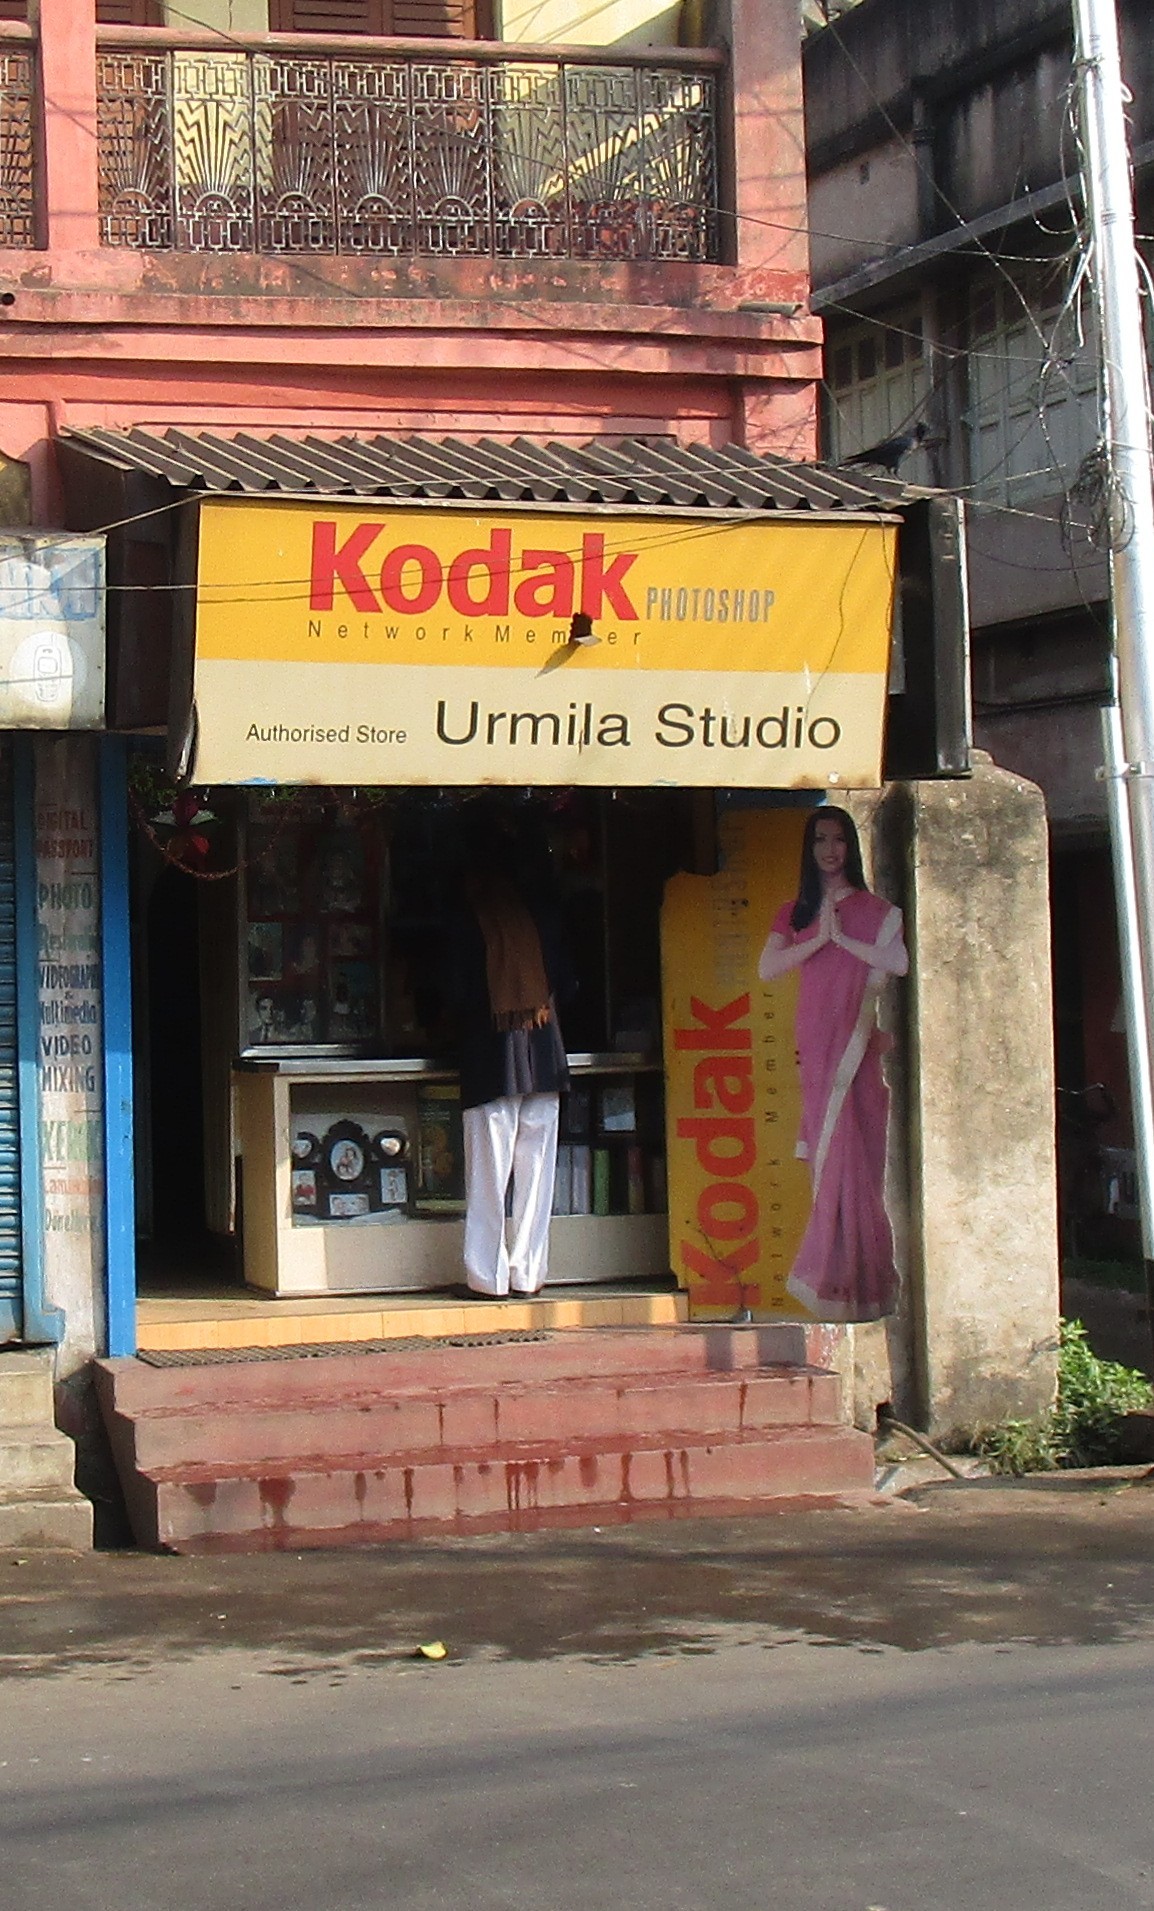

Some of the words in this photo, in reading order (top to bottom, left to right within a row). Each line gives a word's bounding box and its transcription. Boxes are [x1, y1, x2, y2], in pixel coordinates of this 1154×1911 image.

[309, 521, 639, 621] Kodak
[646, 586, 775, 622] PHOTOSHOP
[308, 620, 474, 641] Network
[495, 623, 642, 646] Memer
[246, 723, 350, 743] Authorised
[356, 725, 407, 744] Store
[436, 700, 631, 747] Urmila
[655, 704, 841, 749] Studio
[38, 882, 92, 910] PHOTO
[41, 1034, 92, 1057] VIDEO
[762, 991, 779, 1124] Member
[41, 1065, 96, 1093] MIXING
[673, 991, 761, 1306] Kodak
